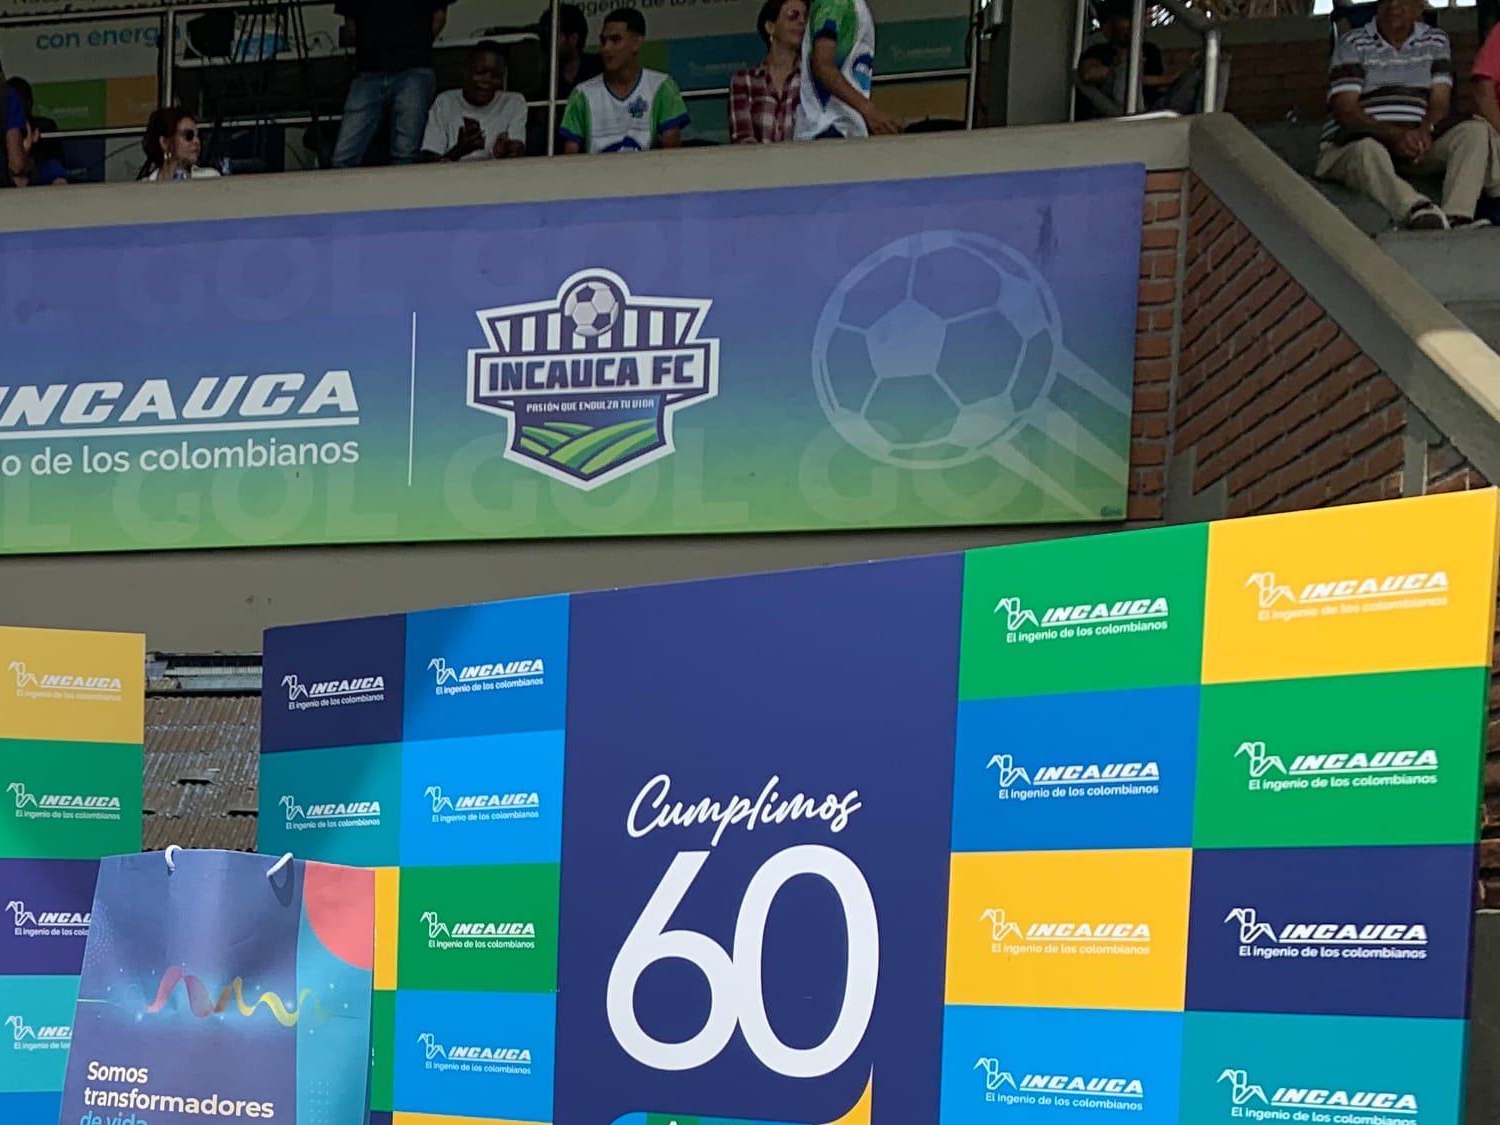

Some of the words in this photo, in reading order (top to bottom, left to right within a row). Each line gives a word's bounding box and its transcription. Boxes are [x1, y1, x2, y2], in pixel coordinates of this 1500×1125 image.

[36, 31, 79, 49] con
[489, 357, 639, 391] INCAUCA
[653, 354, 695, 384] FC
[526, 400, 560, 413] PASIÓN
[561, 401, 578, 411] QUE
[620, 400, 632, 409] TU
[33, 447, 72, 475] de
[83, 444, 129, 474] los
[139, 438, 359, 472] colombianos
[1300, 572, 1448, 599] INCAUCA
[1042, 598, 1168, 622] INCAUCA
[1007, 630, 1016, 642] El
[1019, 630, 1058, 641] ingenio
[1060, 628, 1074, 637] de
[1077, 627, 1092, 636] los
[1095, 621, 1167, 635] colombianos
[460, 660, 543, 679] INCAUCA
[41, 675, 121, 688] INCAUCA
[310, 677, 384, 695] INCAUCA
[444, 684, 470, 695] ingenio
[472, 683, 482, 691] de
[496, 678, 543, 689] colombianos
[1290, 750, 1437, 770] INCAUCA
[1034, 762, 1158, 781] INCAUCA
[999, 789, 1008, 799] El
[1011, 788, 1050, 799] ingenio
[1052, 787, 1066, 797] de
[1069, 787, 1084, 796] los
[1087, 785, 1158, 795] colombianos
[1249, 780, 1260, 790] El
[1263, 779, 1308, 791] ingenio
[1311, 778, 1328, 787] de
[1331, 777, 1350, 786] los
[1352, 775, 1437, 786] colombianos
[40, 795, 120, 807] INCAUCA
[307, 802, 380, 815] INCAUCA
[456, 793, 538, 808] INCAUCA
[627, 774, 862, 846] Cumplimos
[452, 924, 534, 934] INCAUCA
[1027, 924, 1150, 938] INCAUCA
[1280, 925, 1426, 939] INCAUCA
[606, 844, 879, 1078] 60
[1240, 946, 1251, 956] El
[1254, 946, 1298, 958] ingenio
[1301, 947, 1318, 957] de
[1320, 947, 1340, 957] los
[1342, 947, 1426, 958] colombianos
[449, 1047, 530, 1061] INCAUCA
[87, 1061, 148, 1084] Somos
[1020, 1075, 1142, 1093] INCAUCA
[84, 1087, 275, 1119] transformadores
[1272, 1088, 1416, 1109] INCAUCA
[1232, 1107, 1242, 1117] El
[1246, 1108, 1290, 1120] ingenio
[1293, 1112, 1309, 1120] de
[1312, 1112, 1331, 1122] los
